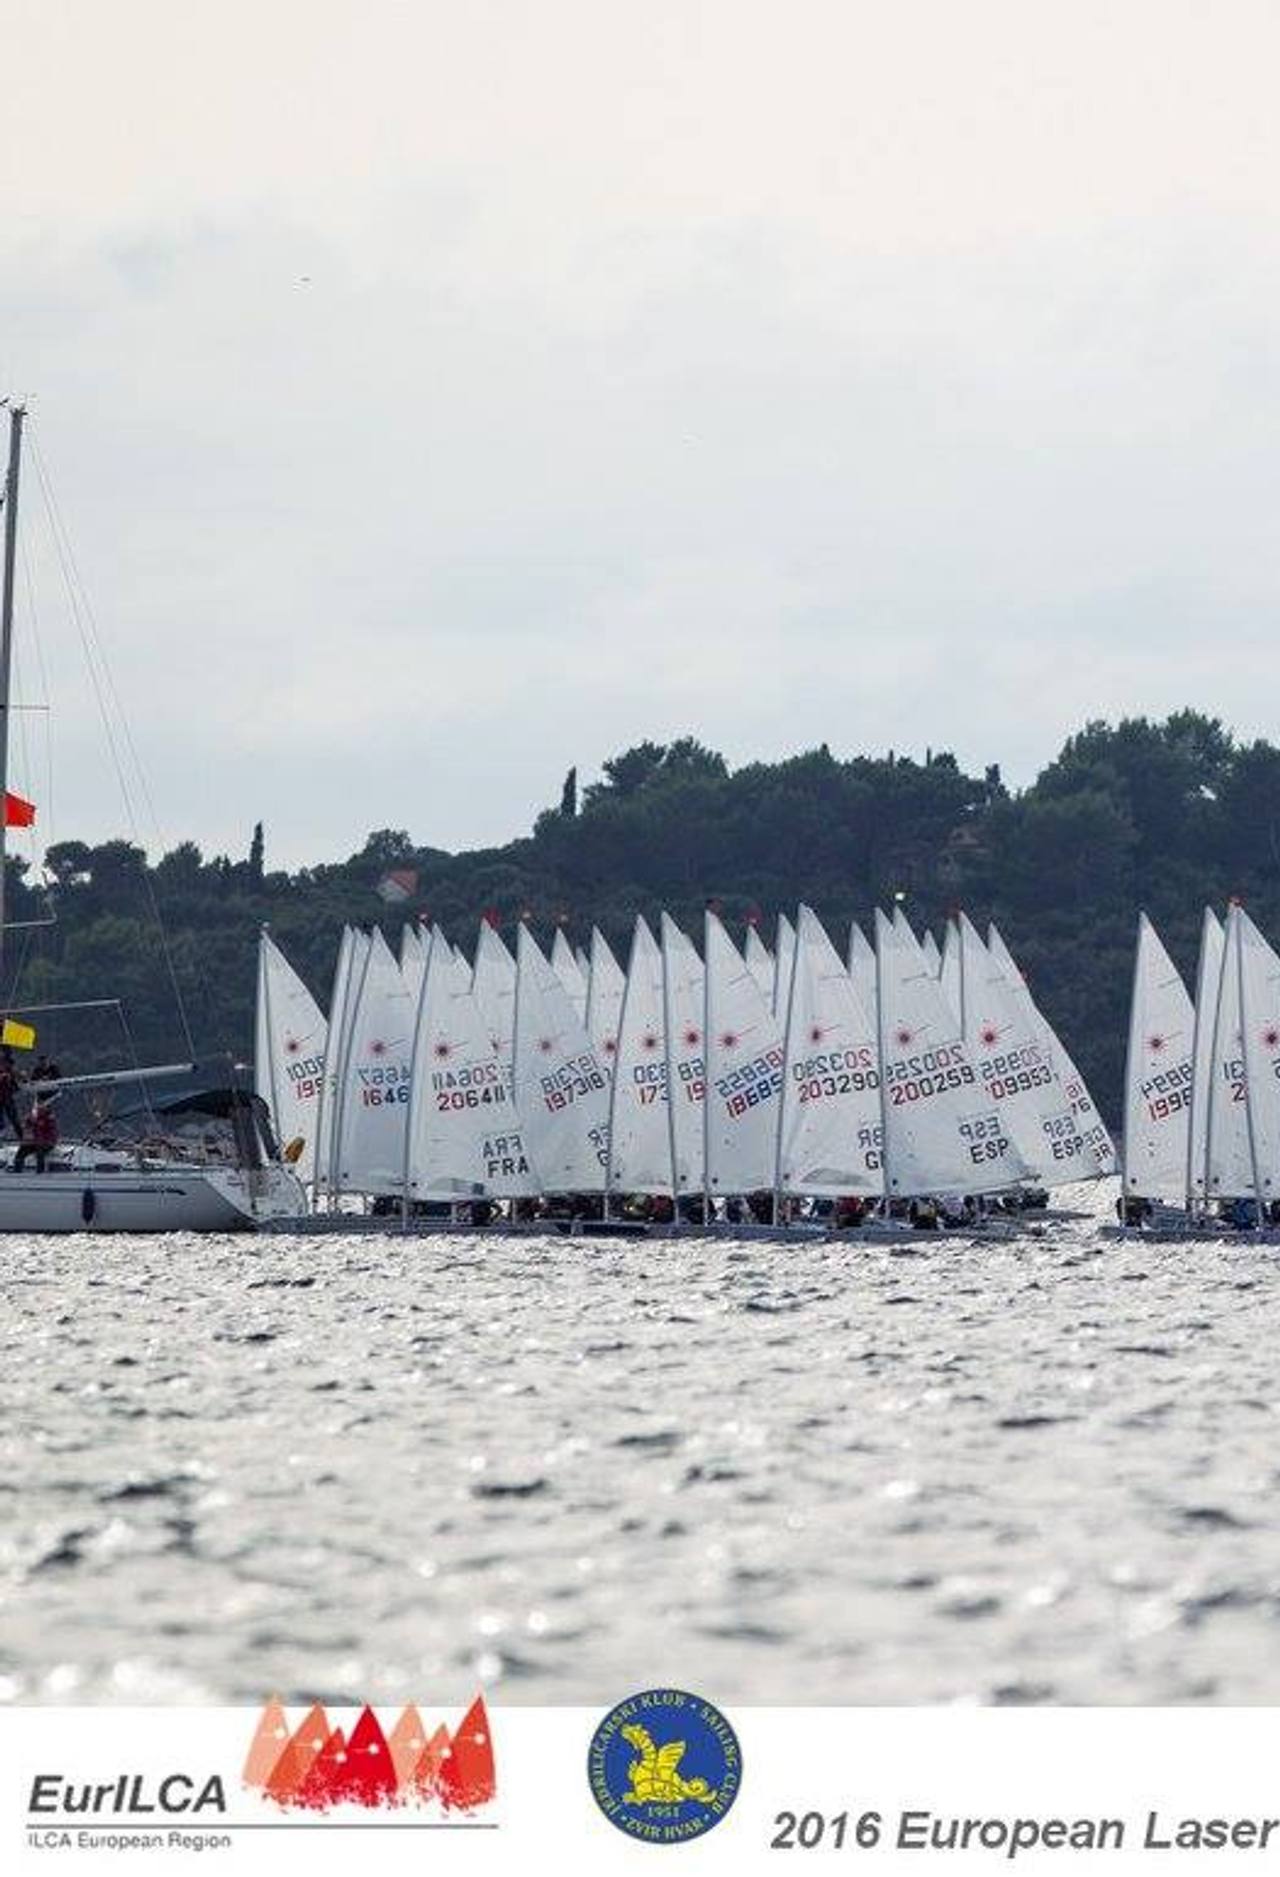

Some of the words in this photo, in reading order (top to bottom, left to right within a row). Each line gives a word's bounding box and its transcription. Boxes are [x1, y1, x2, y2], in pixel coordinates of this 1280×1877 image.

[435, 1085, 506, 1112] 206411
[799, 1070, 880, 1103] 203290
[891, 1065, 975, 1106] 200259
[970, 1137, 1009, 1165] ESP
[487, 1155, 530, 1179] FRA
